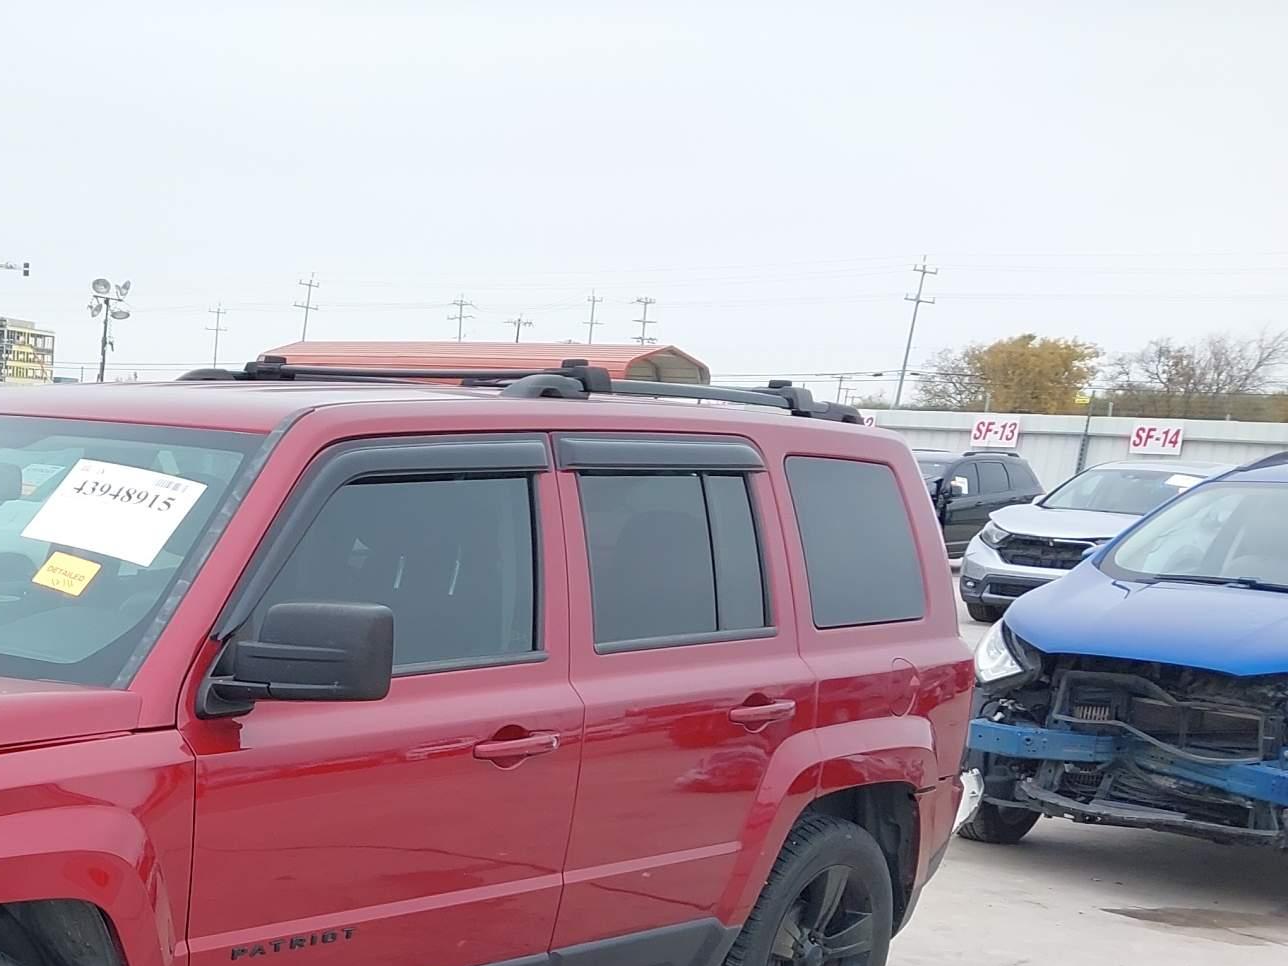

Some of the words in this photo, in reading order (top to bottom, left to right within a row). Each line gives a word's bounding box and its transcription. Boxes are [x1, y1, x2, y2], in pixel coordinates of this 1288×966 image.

[973, 421, 1017, 441] SF-13
[1132, 427, 1181, 448] SF-14
[73, 479, 176, 512] 43948915
[230, 927, 355, 961] PATRIOT
